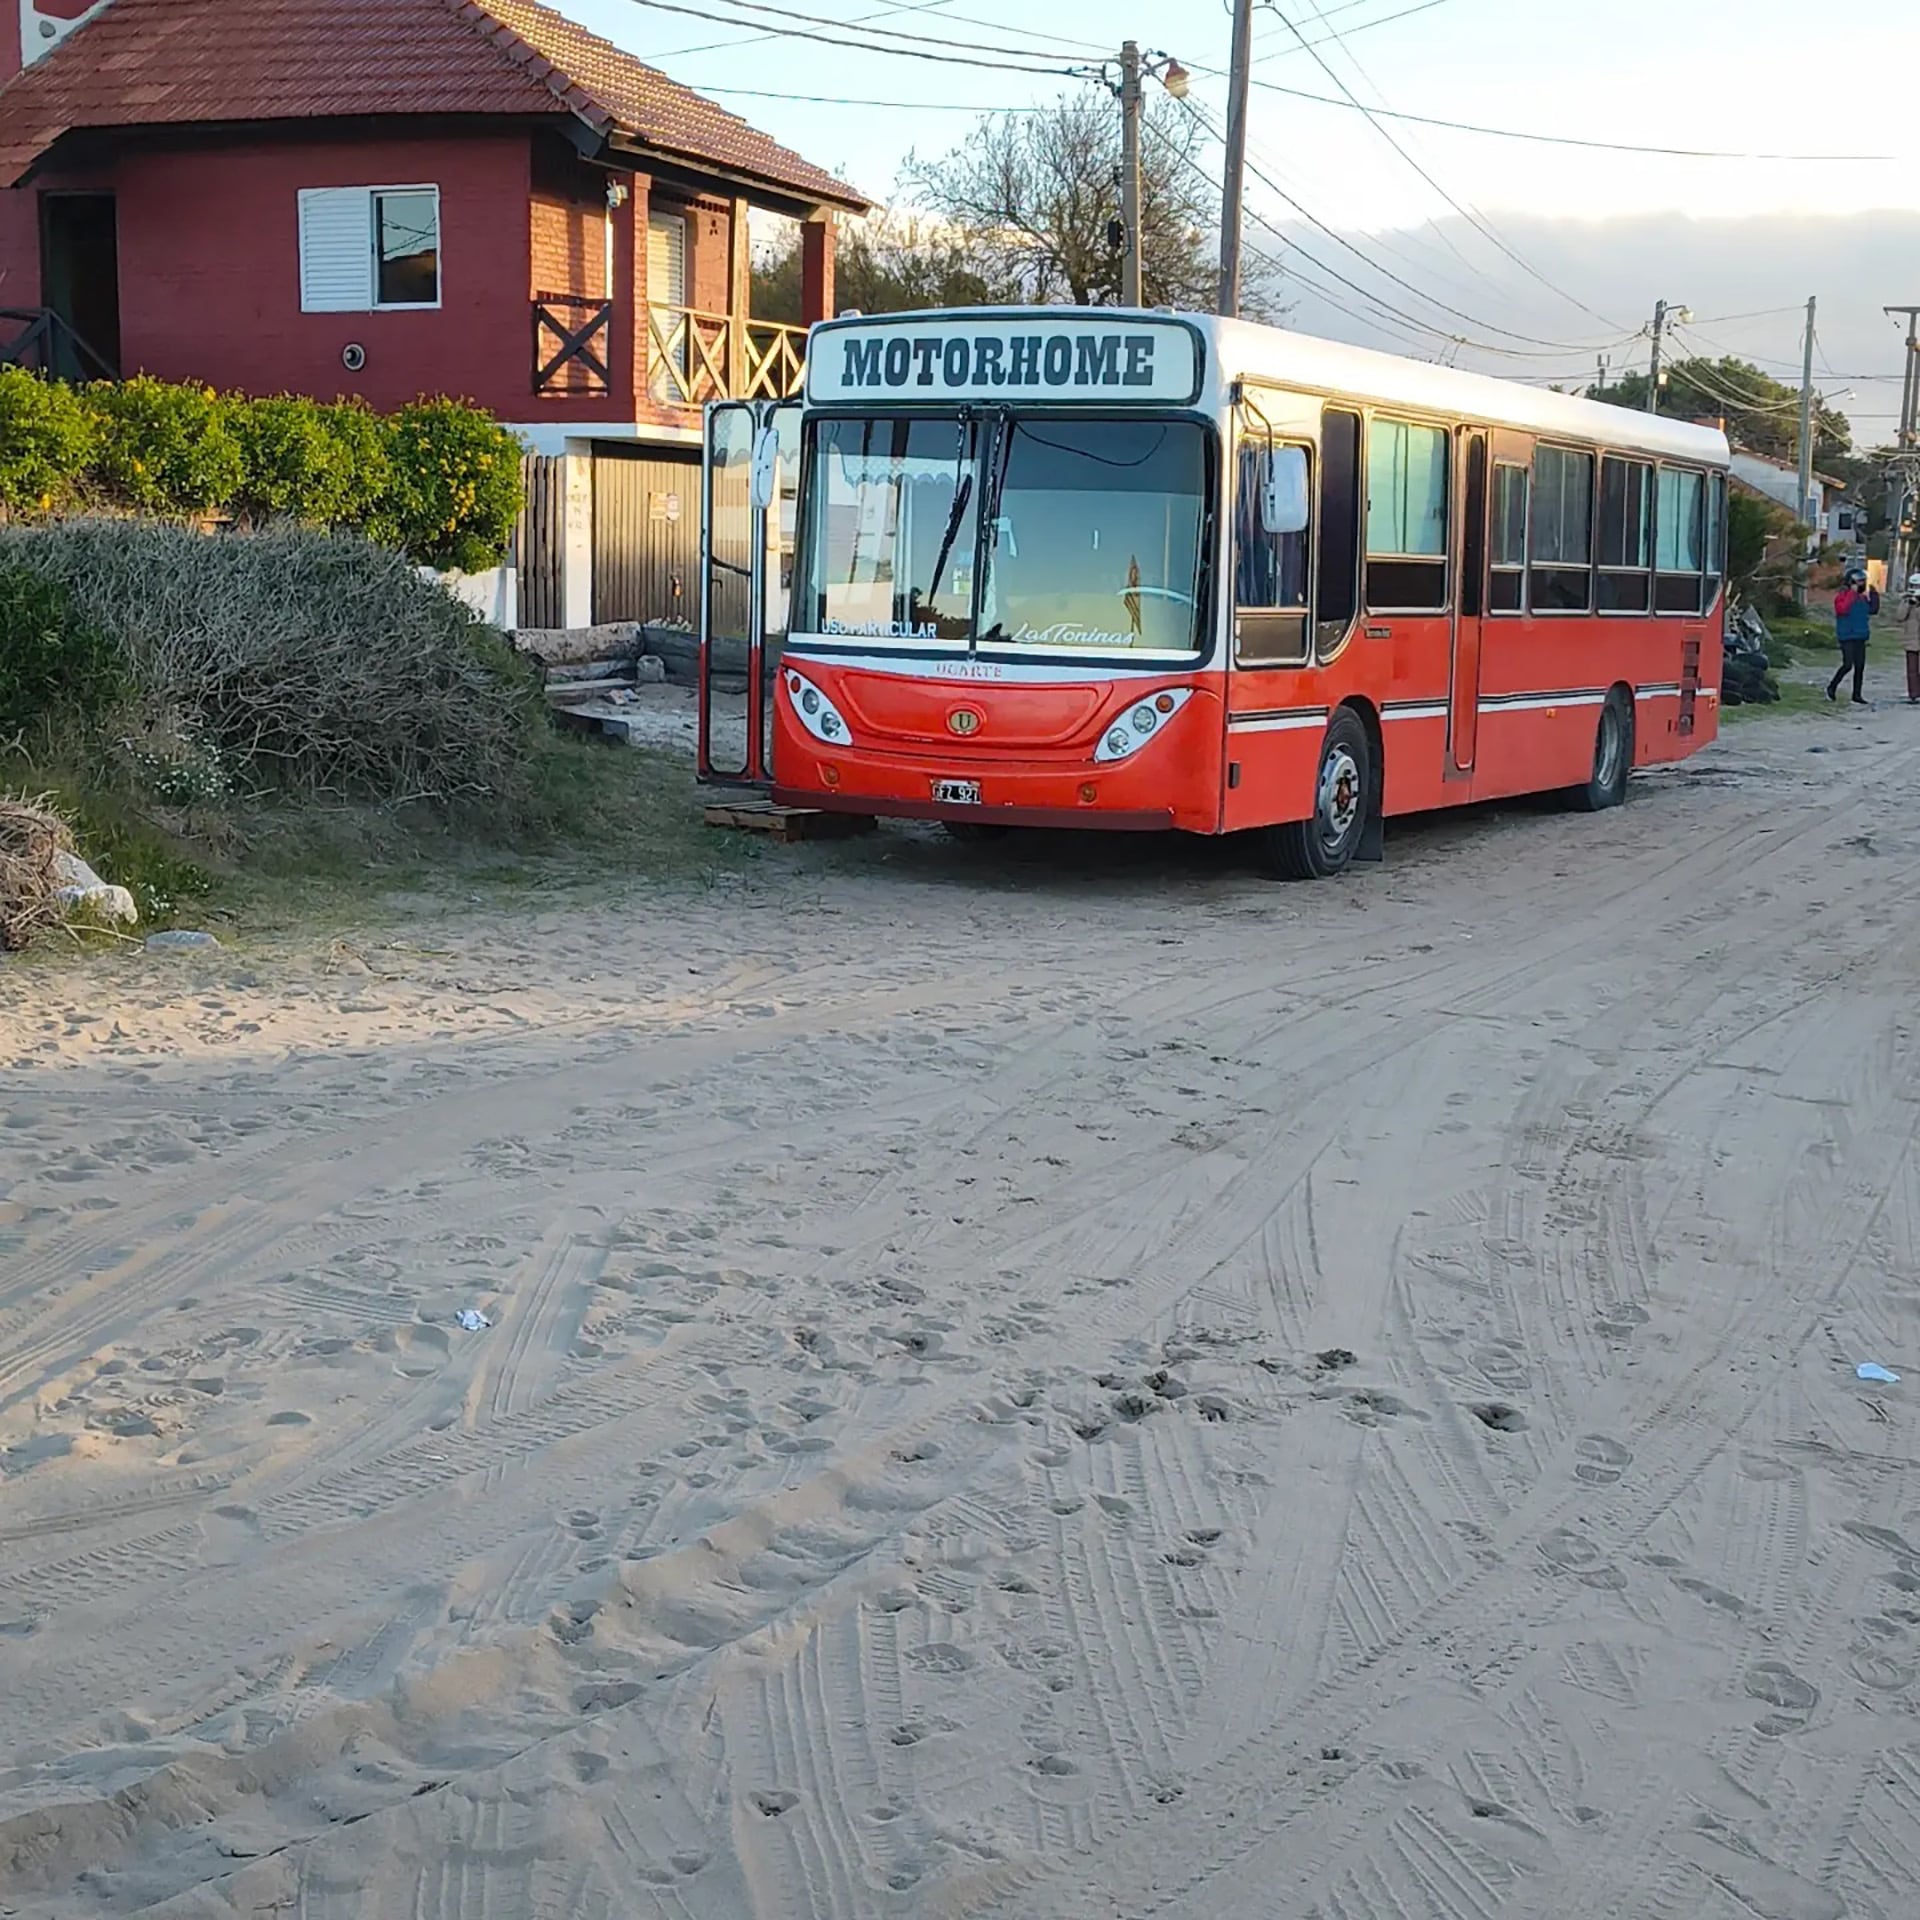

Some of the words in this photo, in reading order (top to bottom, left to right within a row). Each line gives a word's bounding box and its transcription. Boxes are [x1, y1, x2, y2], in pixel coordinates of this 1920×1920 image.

[841, 335, 1155, 387] MOTORHOME
[1011, 622, 1051, 645] Las
[1049, 623, 1135, 643] Toninas
[959, 713, 972, 730] U
